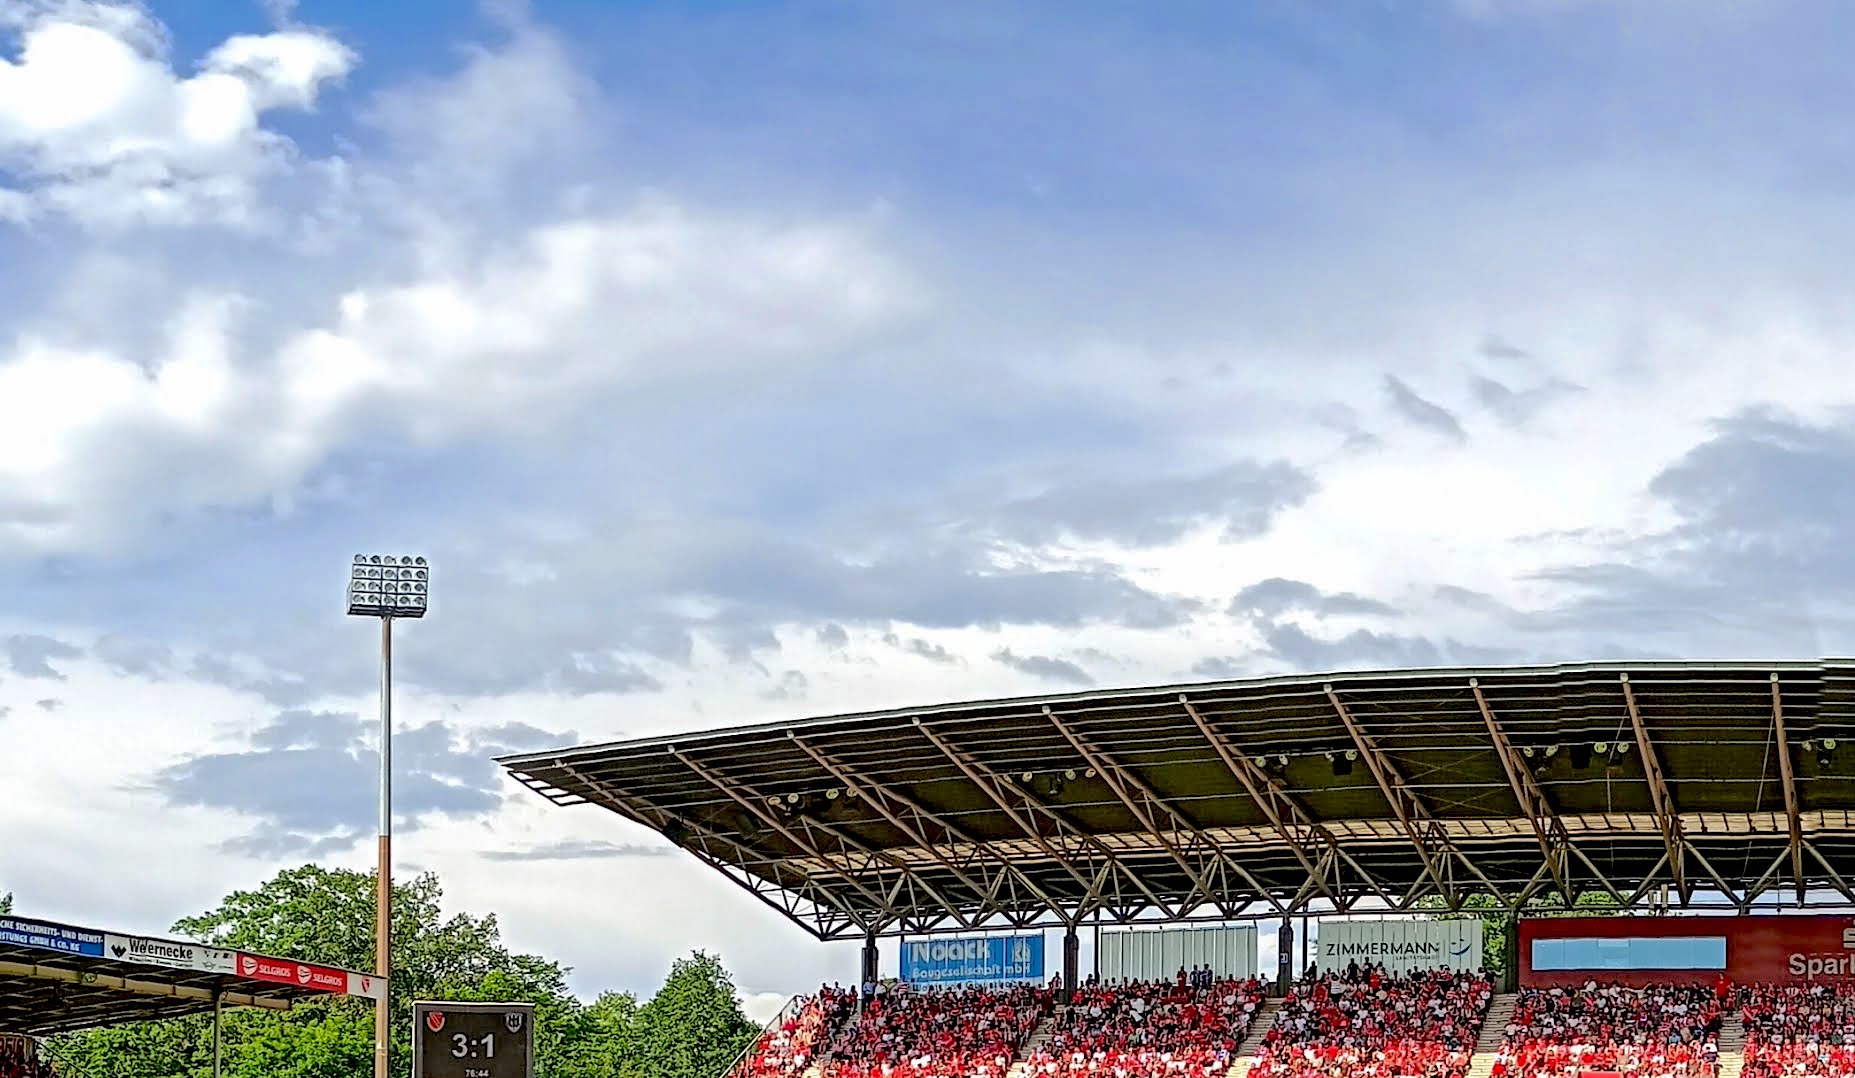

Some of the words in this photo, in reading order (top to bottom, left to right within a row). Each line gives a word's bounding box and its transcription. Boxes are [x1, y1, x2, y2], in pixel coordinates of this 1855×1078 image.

[61, 929, 77, 940] UND
[912, 939, 991, 963] Noack
[1326, 942, 1440, 956] ZIMMERMANN
[259, 963, 291, 977] SELGROS
[1005, 963, 1031, 974] mbH
[313, 973, 343, 986] SELGROS
[451, 1033, 495, 1058] 3:1
